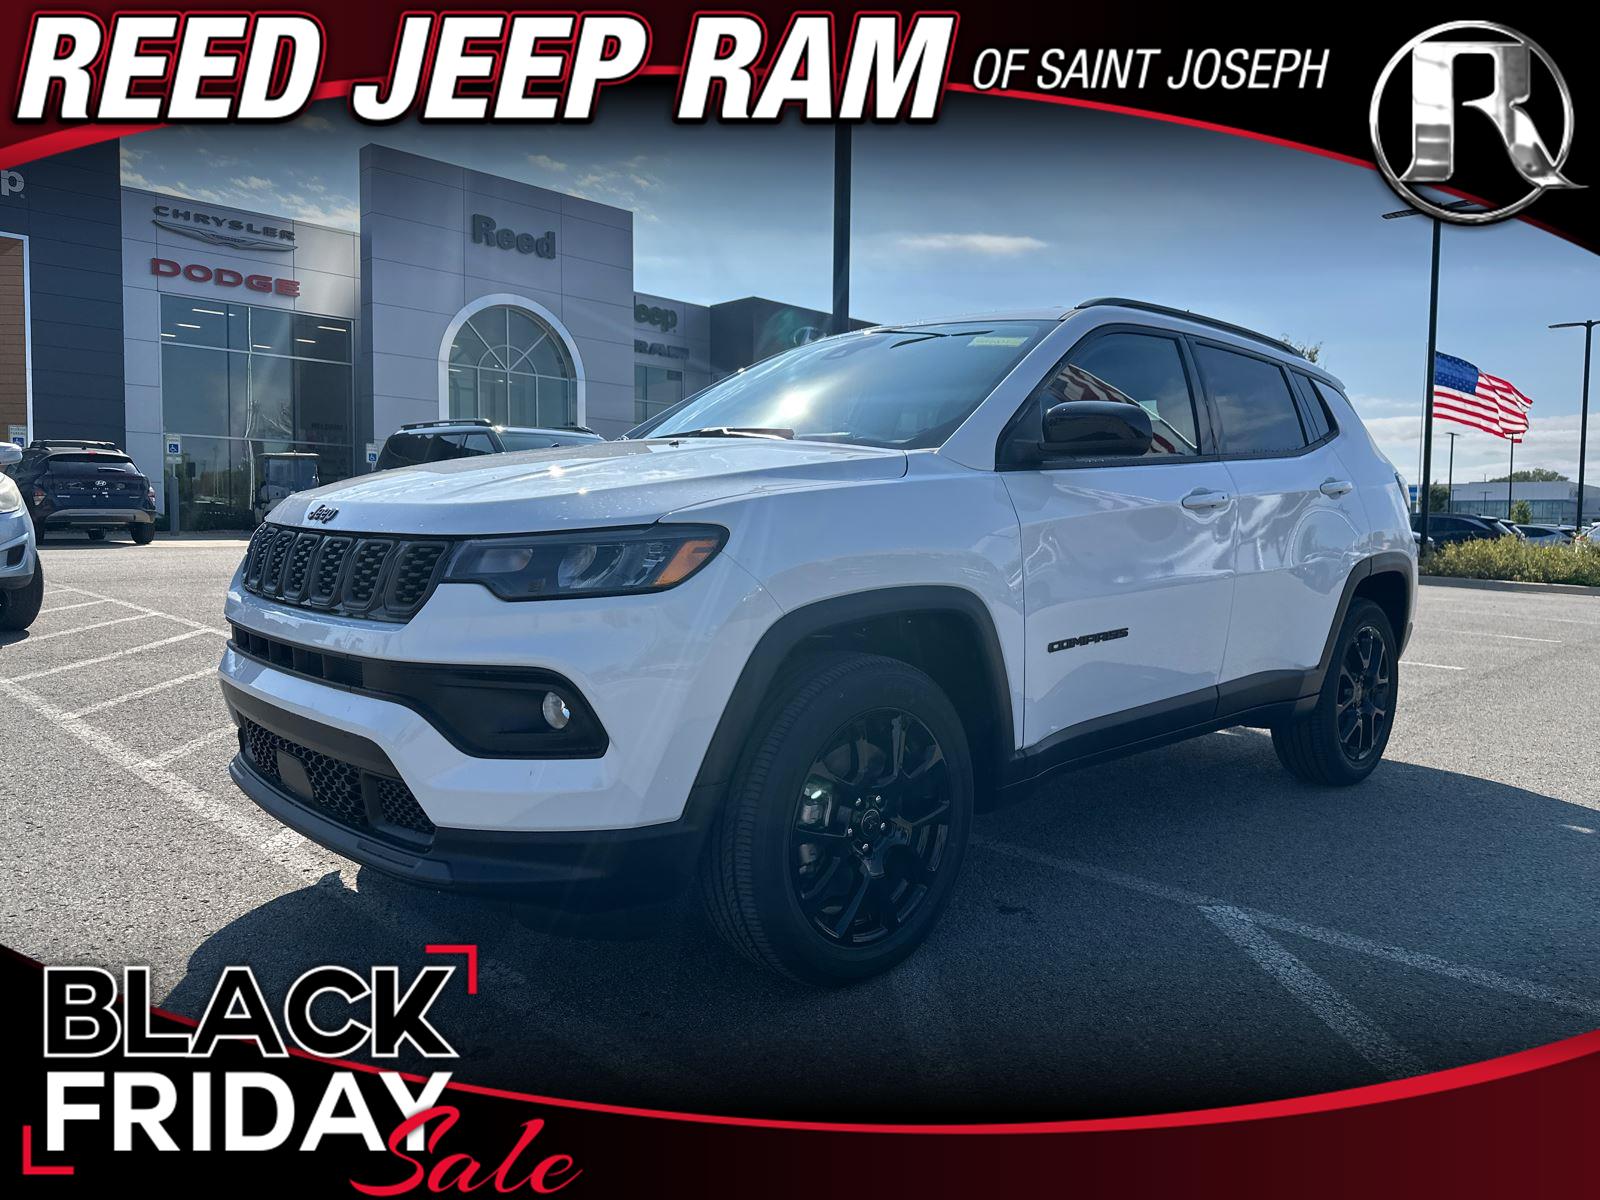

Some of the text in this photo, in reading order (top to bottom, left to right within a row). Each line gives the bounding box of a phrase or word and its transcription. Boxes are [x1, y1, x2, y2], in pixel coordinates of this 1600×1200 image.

[152, 205, 296, 242] CHRYSLER
[472, 213, 557, 260] Reed
[151, 258, 301, 297] DODGE
[307, 504, 340, 525] Jeep
[1047, 627, 1129, 654] COMPASS
